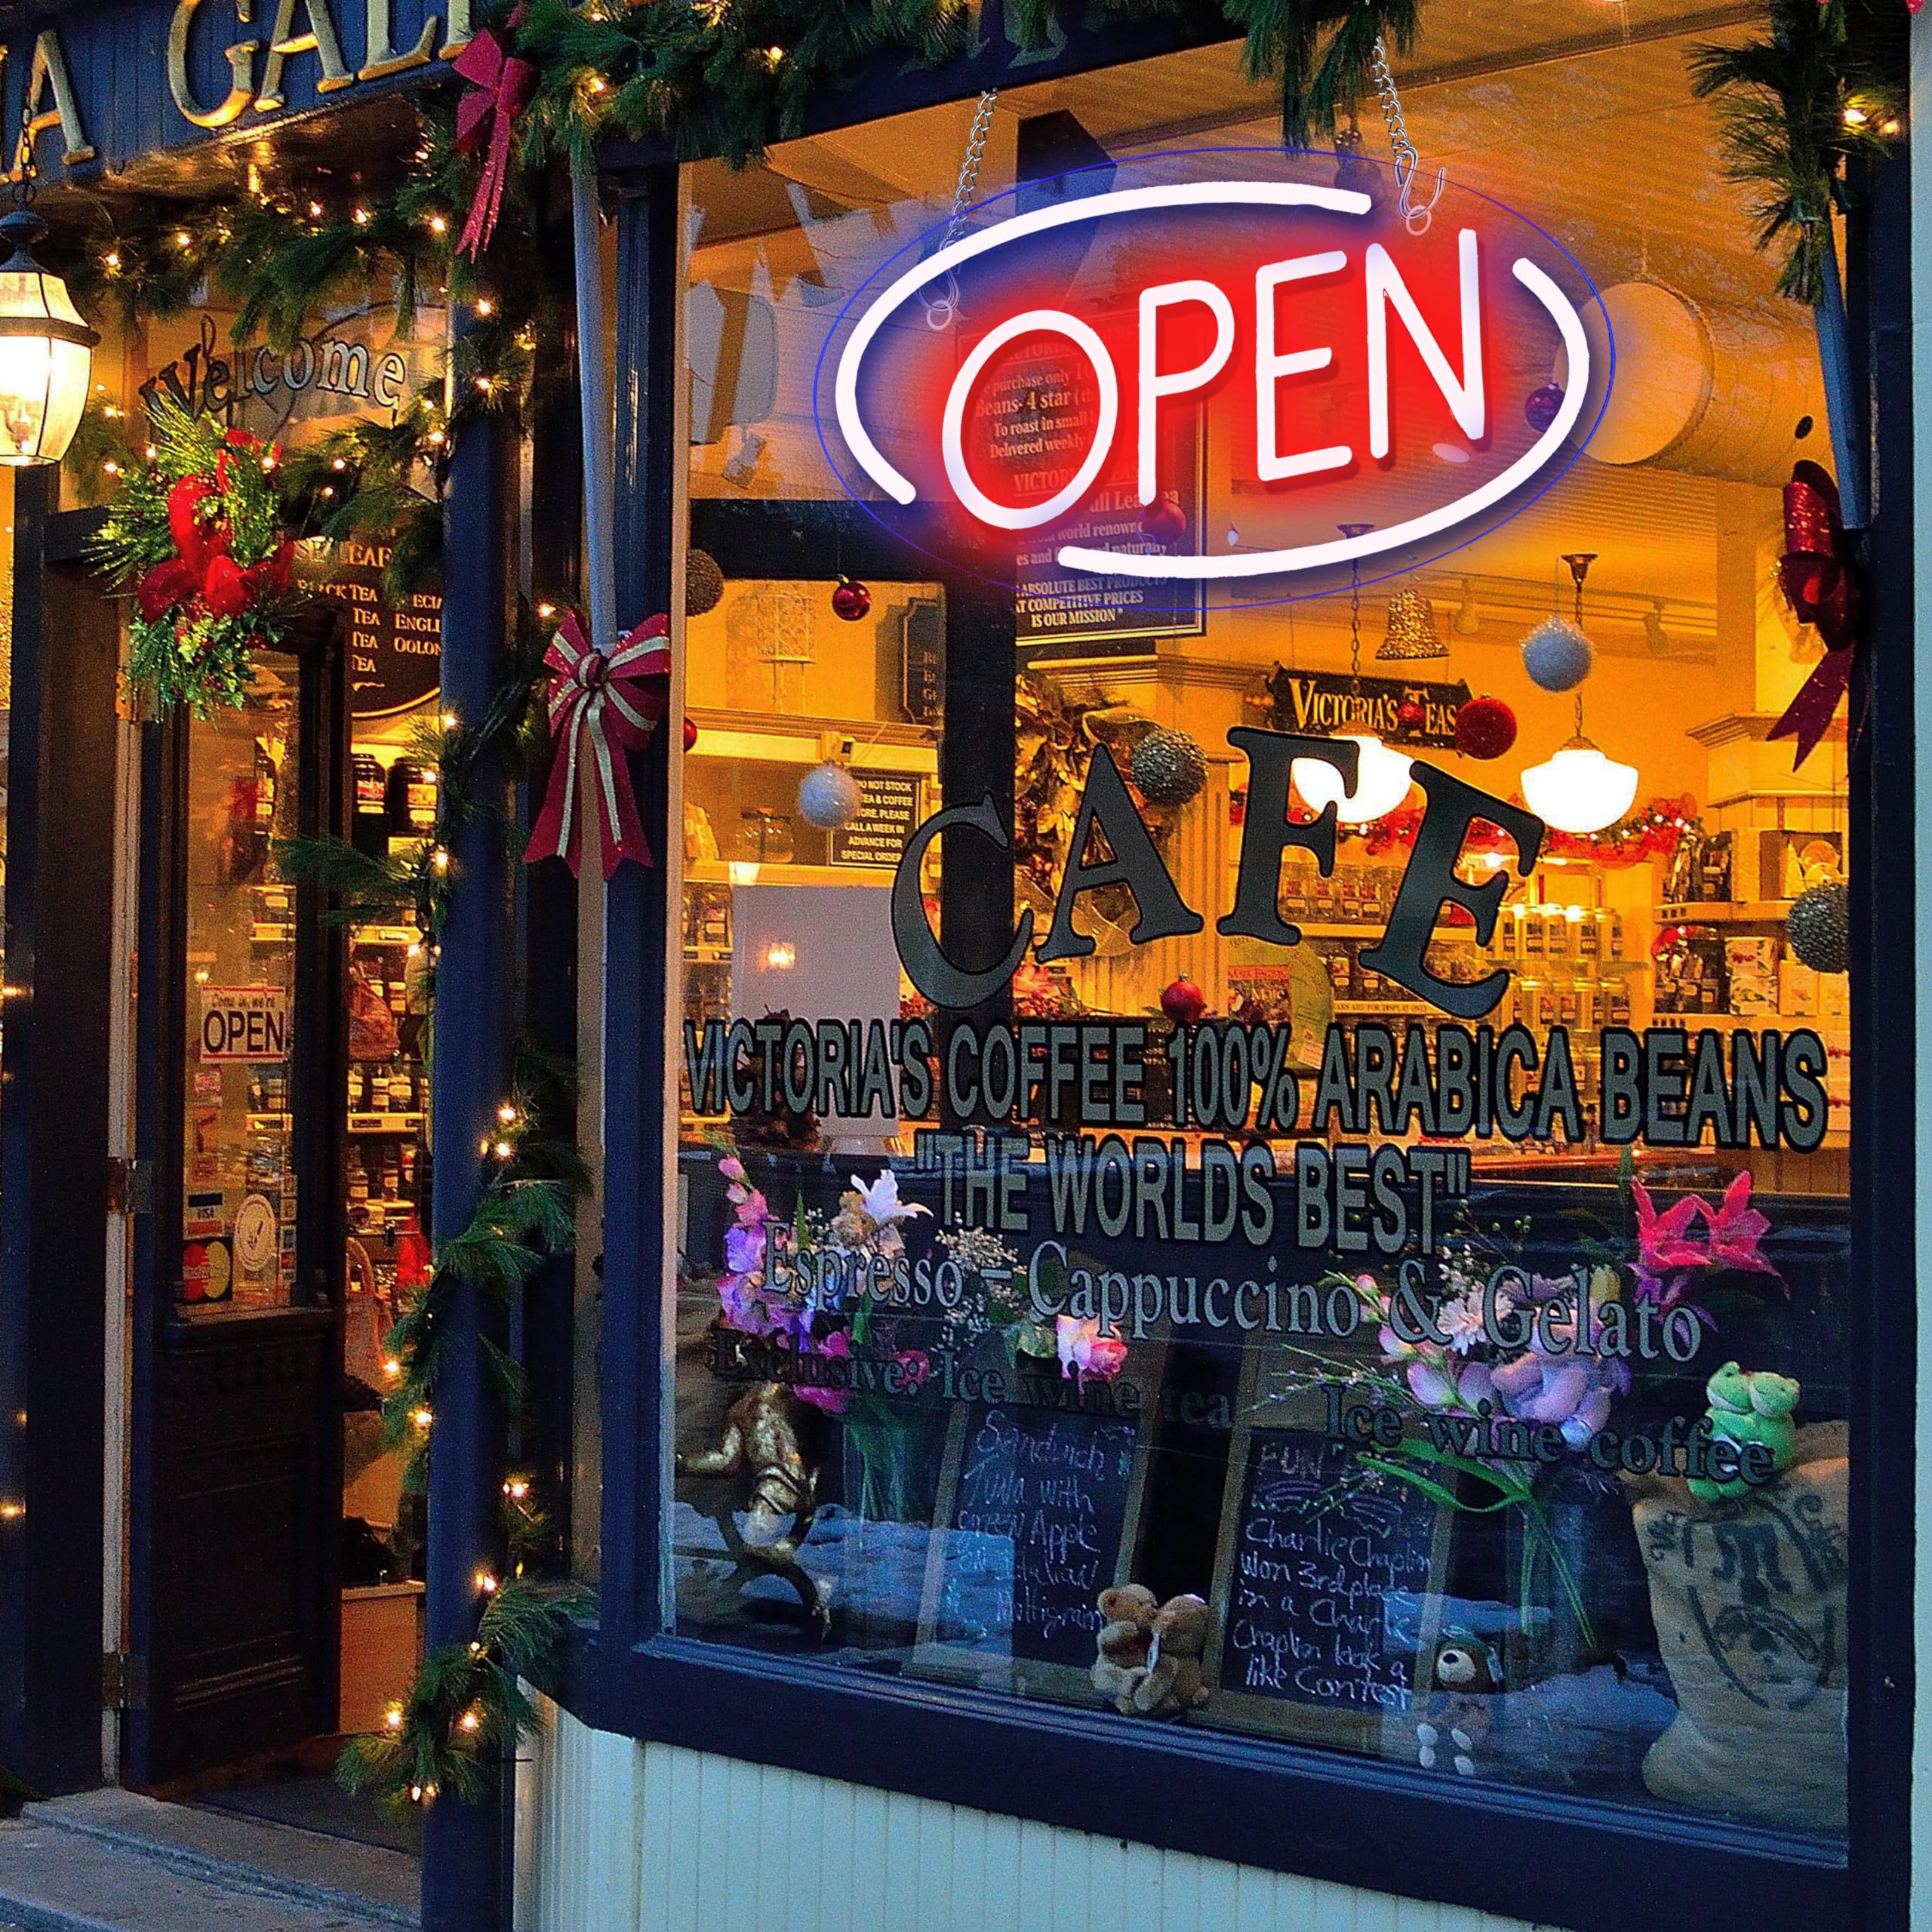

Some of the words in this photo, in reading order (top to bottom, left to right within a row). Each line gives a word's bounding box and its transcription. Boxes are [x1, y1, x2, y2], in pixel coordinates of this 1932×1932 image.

[168, 0, 472, 128] GAL
[138, 314, 407, 441] Welcome
[942, 227, 1486, 530] OPEN
[992, 374, 1044, 396] purchase
[1026, 391, 1037, 411] 4
[1040, 391, 1072, 409] star
[993, 423, 1009, 438] To
[1010, 420, 1039, 435] roast
[1041, 417, 1054, 432] in
[1055, 411, 1088, 429] small
[989, 438, 1044, 458] Delivered
[1014, 467, 1075, 491] VICTORI
[1089, 491, 1110, 513] ull
[1057, 524, 1091, 541] world
[1094, 521, 1144, 537] renowne
[1030, 549, 1053, 565] and
[349, 583, 378, 602] TEA
[1022, 580, 1077, 597] ABSOLUTE
[1078, 577, 1104, 592] BEST
[1104, 576, 1168, 590] PRODUCTS
[1028, 593, 1103, 612] COMPETITIVE
[1103, 590, 1145, 605] PRICES
[352, 607, 380, 626] TEA
[395, 613, 441, 633] ENGLI
[1032, 614, 1043, 628] IS
[1044, 612, 1068, 627] OUR
[1069, 608, 1117, 624] MISSION
[352, 631, 379, 649] TEA
[394, 636, 442, 656] OOLON
[352, 654, 377, 672] TEA
[1287, 678, 1399, 731] VICTORIA'S
[868, 780, 884, 790] NOT
[884, 781, 912, 792] STOCK
[875, 794, 881, 804] &
[882, 795, 913, 807] COFFEE
[879, 809, 911, 821] PLEASE
[844, 822, 865, 832] CALL
[866, 823, 872, 832] A
[872, 823, 896, 834] WEEK
[896, 824, 905, 834] IN
[848, 835, 885, 847] ADVANCE
[885, 838, 903, 848] FOR
[841, 850, 875, 861] SPECIAL
[875, 851, 903, 863] ORDER
[891, 726, 1546, 1020] CAFE
[204, 1010, 285, 1054] OPEN
[683, 1018, 933, 1119] VICTORIA'S
[946, 1020, 1149, 1128] COFFEE
[1167, 1023, 1298, 1131] 100%
[1312, 1022, 1585, 1143] ARABICA
[1599, 1027, 1828, 1155] BEANS
[914, 1130, 1031, 1234] "THE
[1044, 1133, 1277, 1247] WORLDS
[1294, 1145, 1472, 1256] BEST"
[761, 1218, 965, 1310] Espresso
[1026, 1238, 1361, 1343] Cappuccino
[1389, 1258, 1454, 1346] &
[1481, 1263, 1705, 1363] Gelato
[938, 1347, 1008, 1405] Ice
[1020, 1361, 1143, 1417] wine
[1161, 1383, 1236, 1430] tea
[1322, 1381, 1404, 1447] Ice
[1421, 1398, 1567, 1466] wine
[1587, 1414, 1776, 1487] coffee
